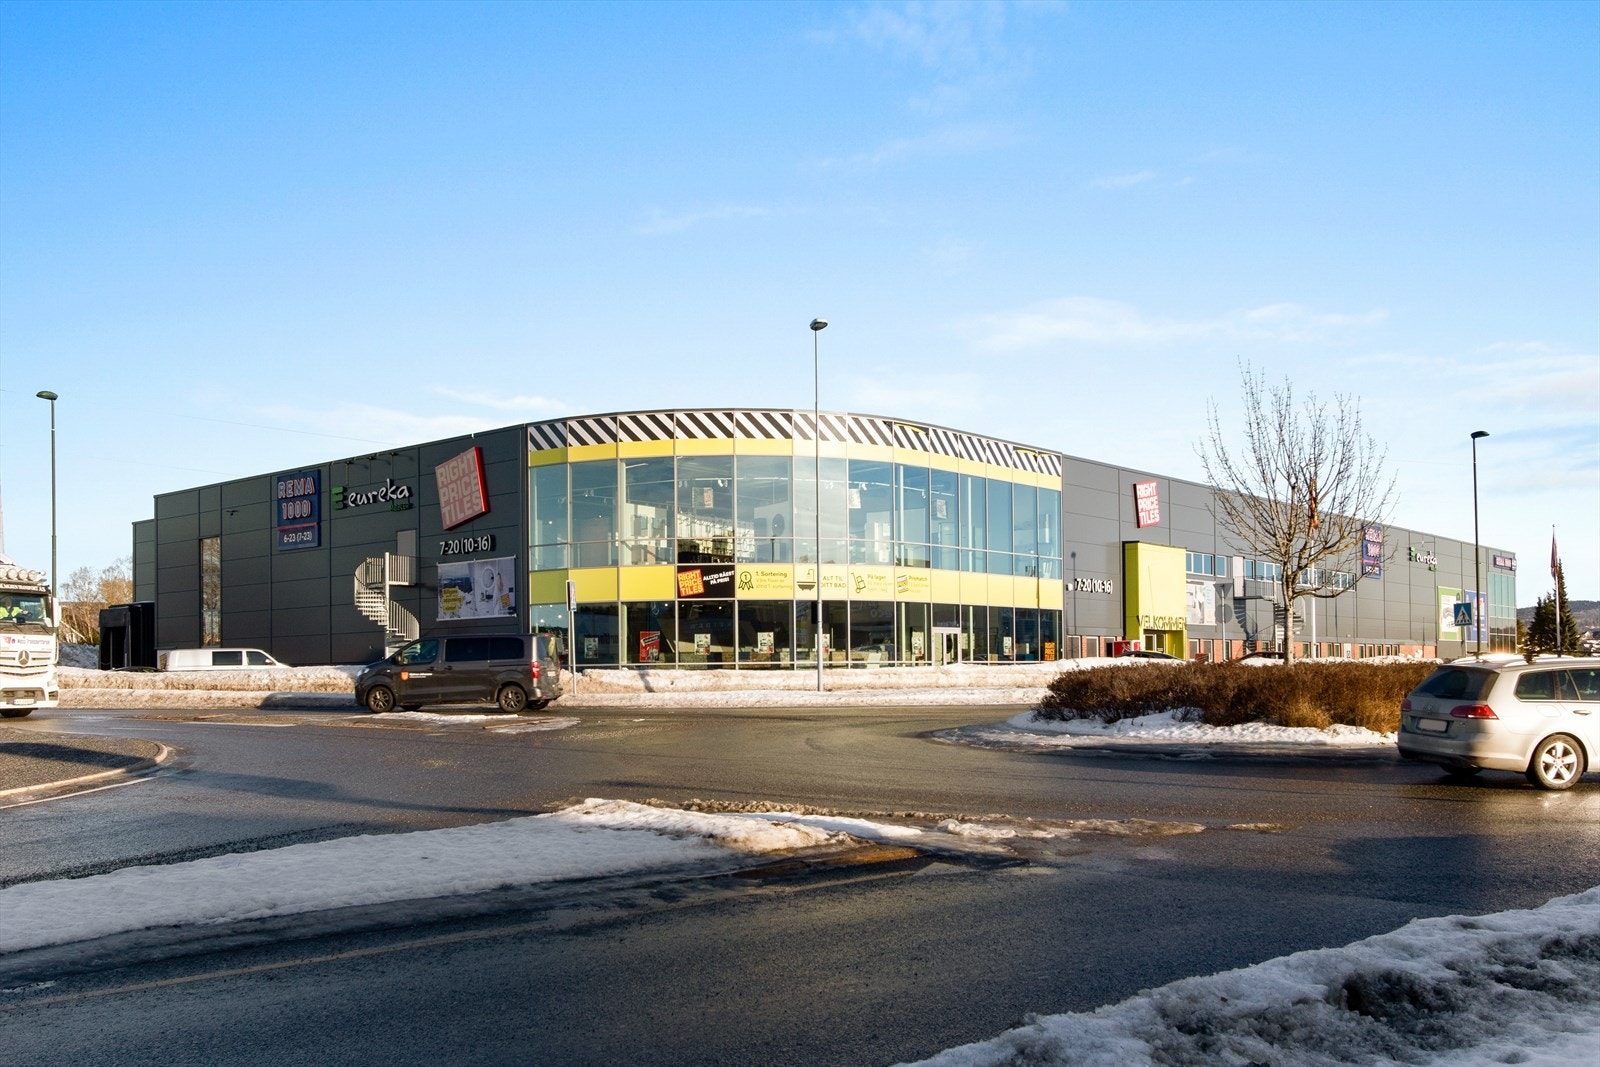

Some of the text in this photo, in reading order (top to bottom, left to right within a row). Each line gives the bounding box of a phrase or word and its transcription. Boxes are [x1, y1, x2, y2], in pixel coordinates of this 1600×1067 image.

[436, 453, 476, 485] RIGHT
[277, 476, 315, 499] REMA
[348, 478, 409, 507] eureka
[439, 470, 480, 507] PRICE
[1137, 482, 1157, 497] RIGHT
[281, 500, 311, 520] 1000
[442, 491, 482, 525] TILES
[1138, 495, 1159, 511] PRICE
[1139, 509, 1160, 524] TILES
[678, 570, 700, 581] RIGHT
[680, 578, 703, 588] PRICE
[681, 585, 703, 595] TILES
[1137, 614, 1187, 631] VELKOMMEN
